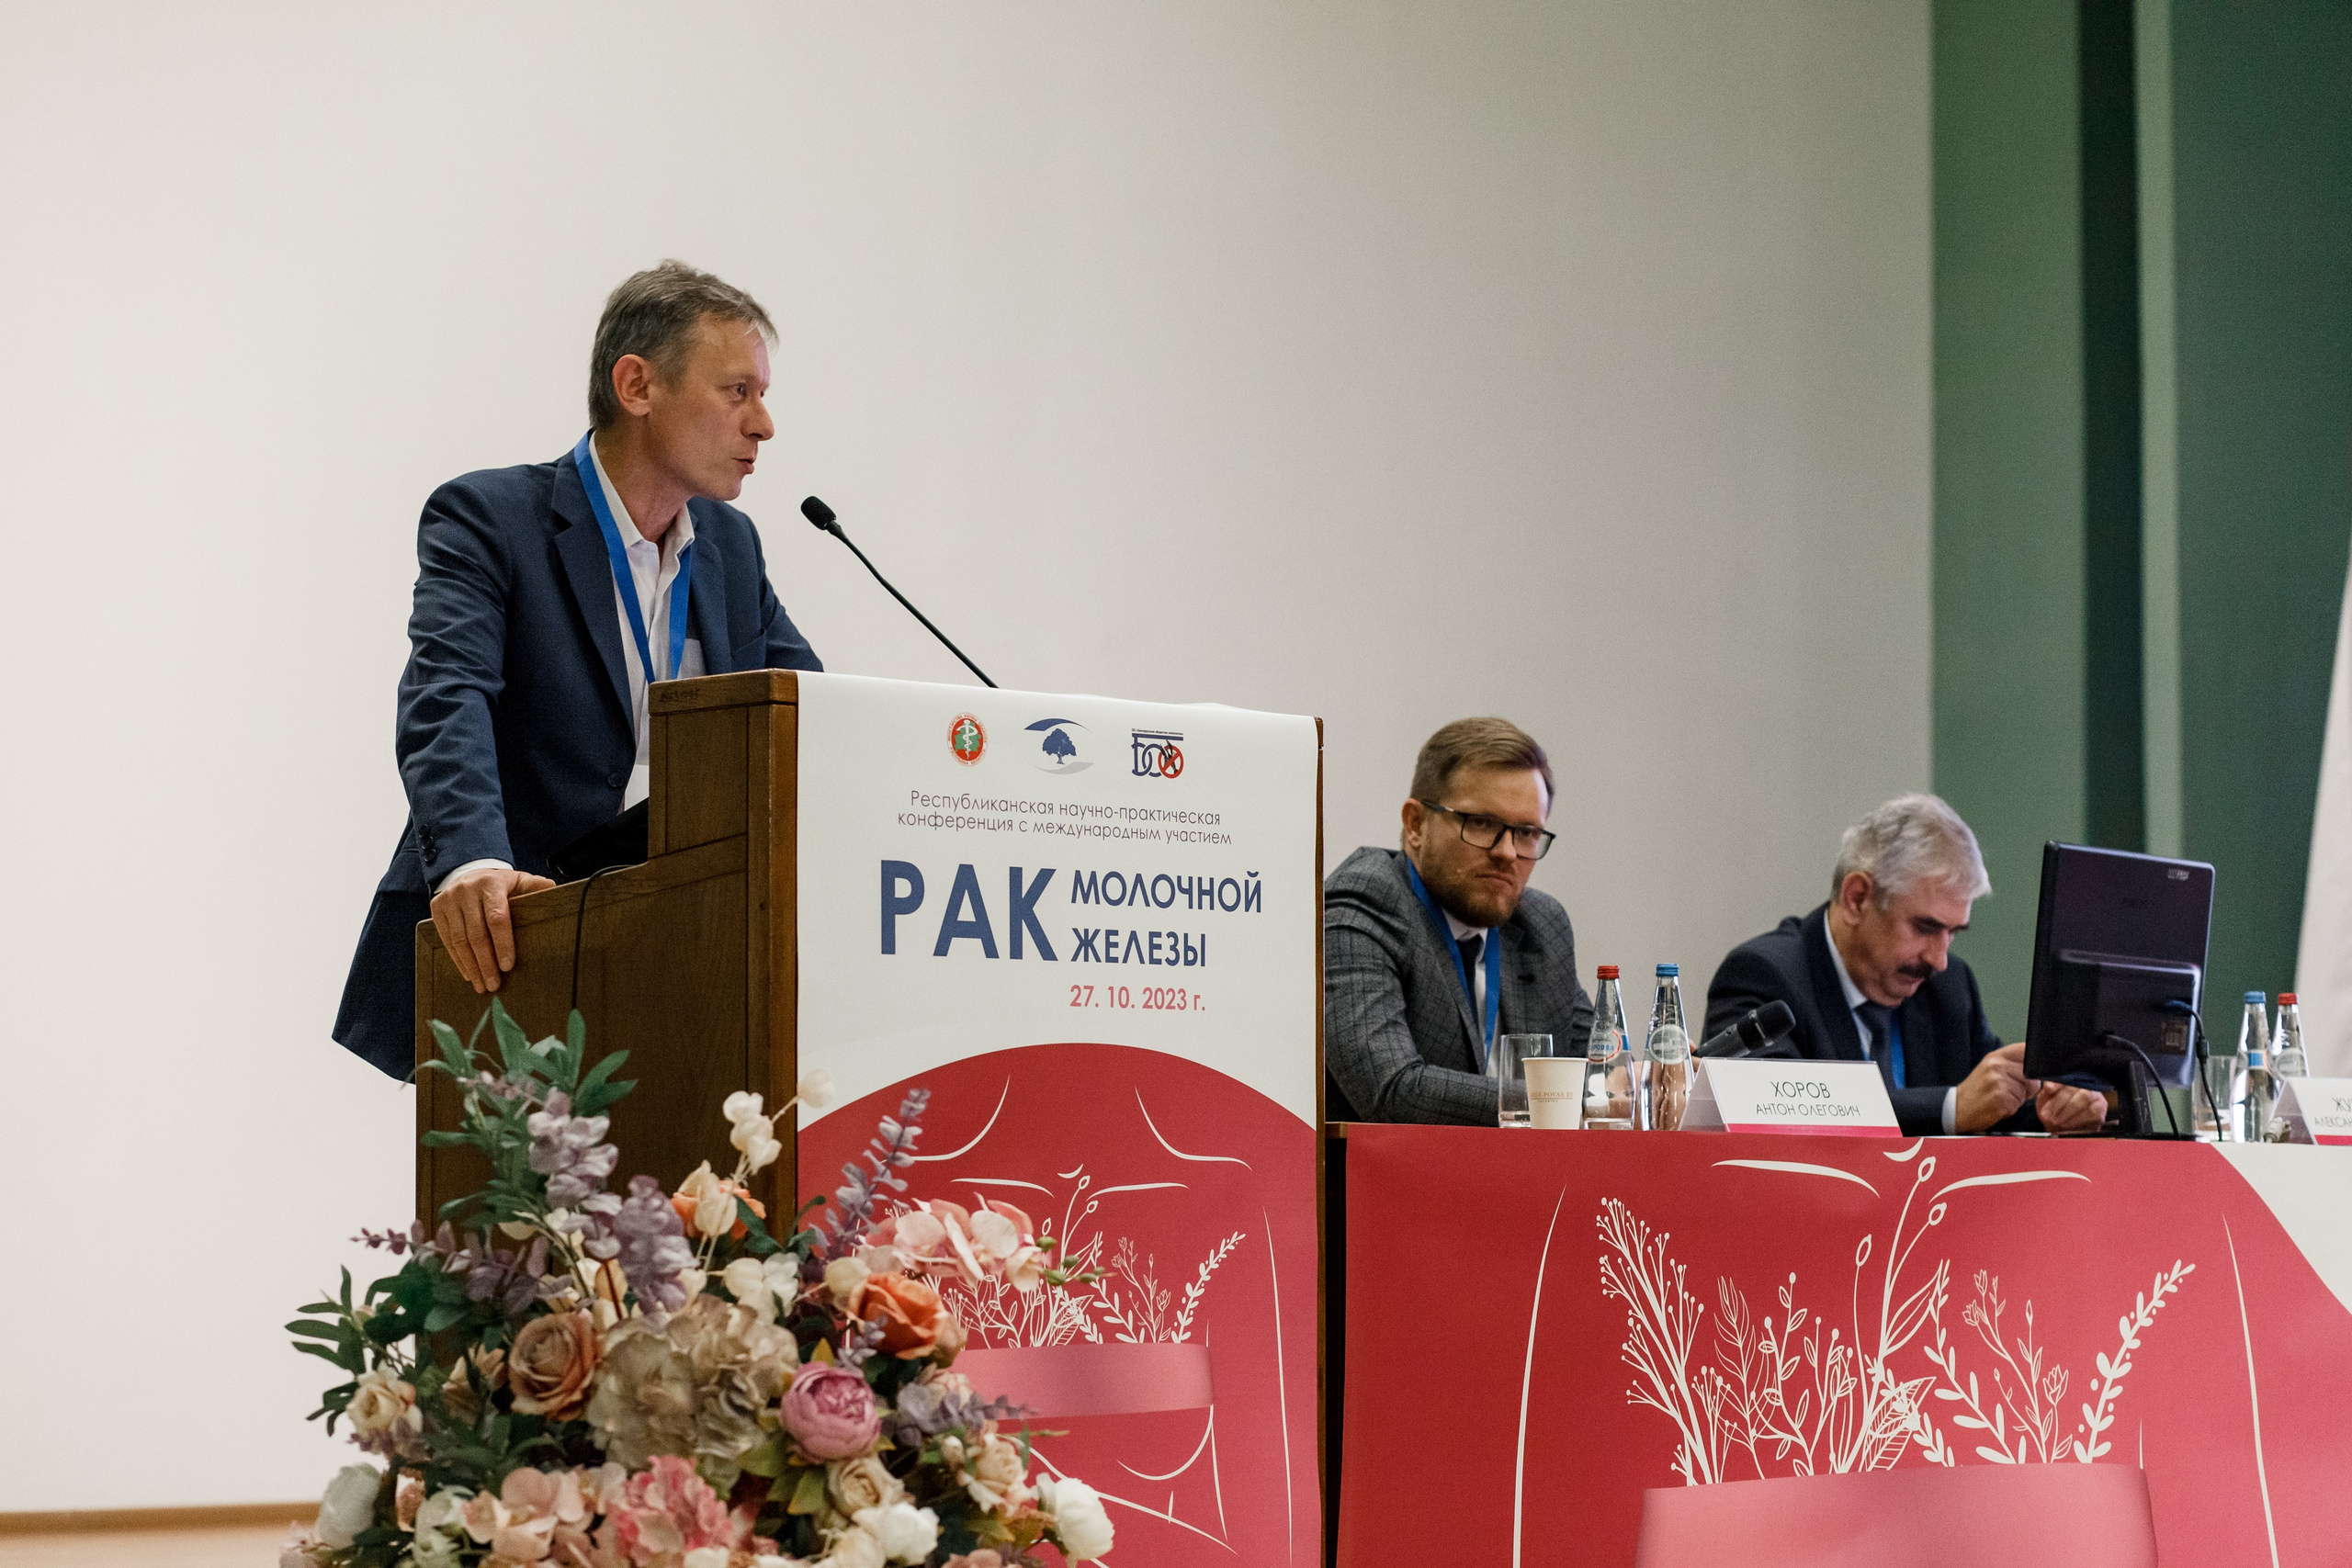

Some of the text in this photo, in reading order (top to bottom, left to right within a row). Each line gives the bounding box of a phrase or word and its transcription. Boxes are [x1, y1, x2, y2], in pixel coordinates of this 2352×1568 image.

[911, 790, 1221, 826] Республиканская научно-практическая
[898, 810, 1232, 845] конференция с международным участием
[1070, 870, 1261, 914] МОЛОЧНОЙ
[880, 859, 1059, 962] РАК
[1070, 928, 1206, 967] ЖЕЛЕЗЫ
[1069, 985, 1206, 1012] 27. 10. 2023 г.
[1770, 1080, 1831, 1100] ХОРОВ
[2331, 1097, 2352, 1113] ЖУ
[1756, 1102, 1861, 1117] АНТОН ОЛЕГОВИЧ
